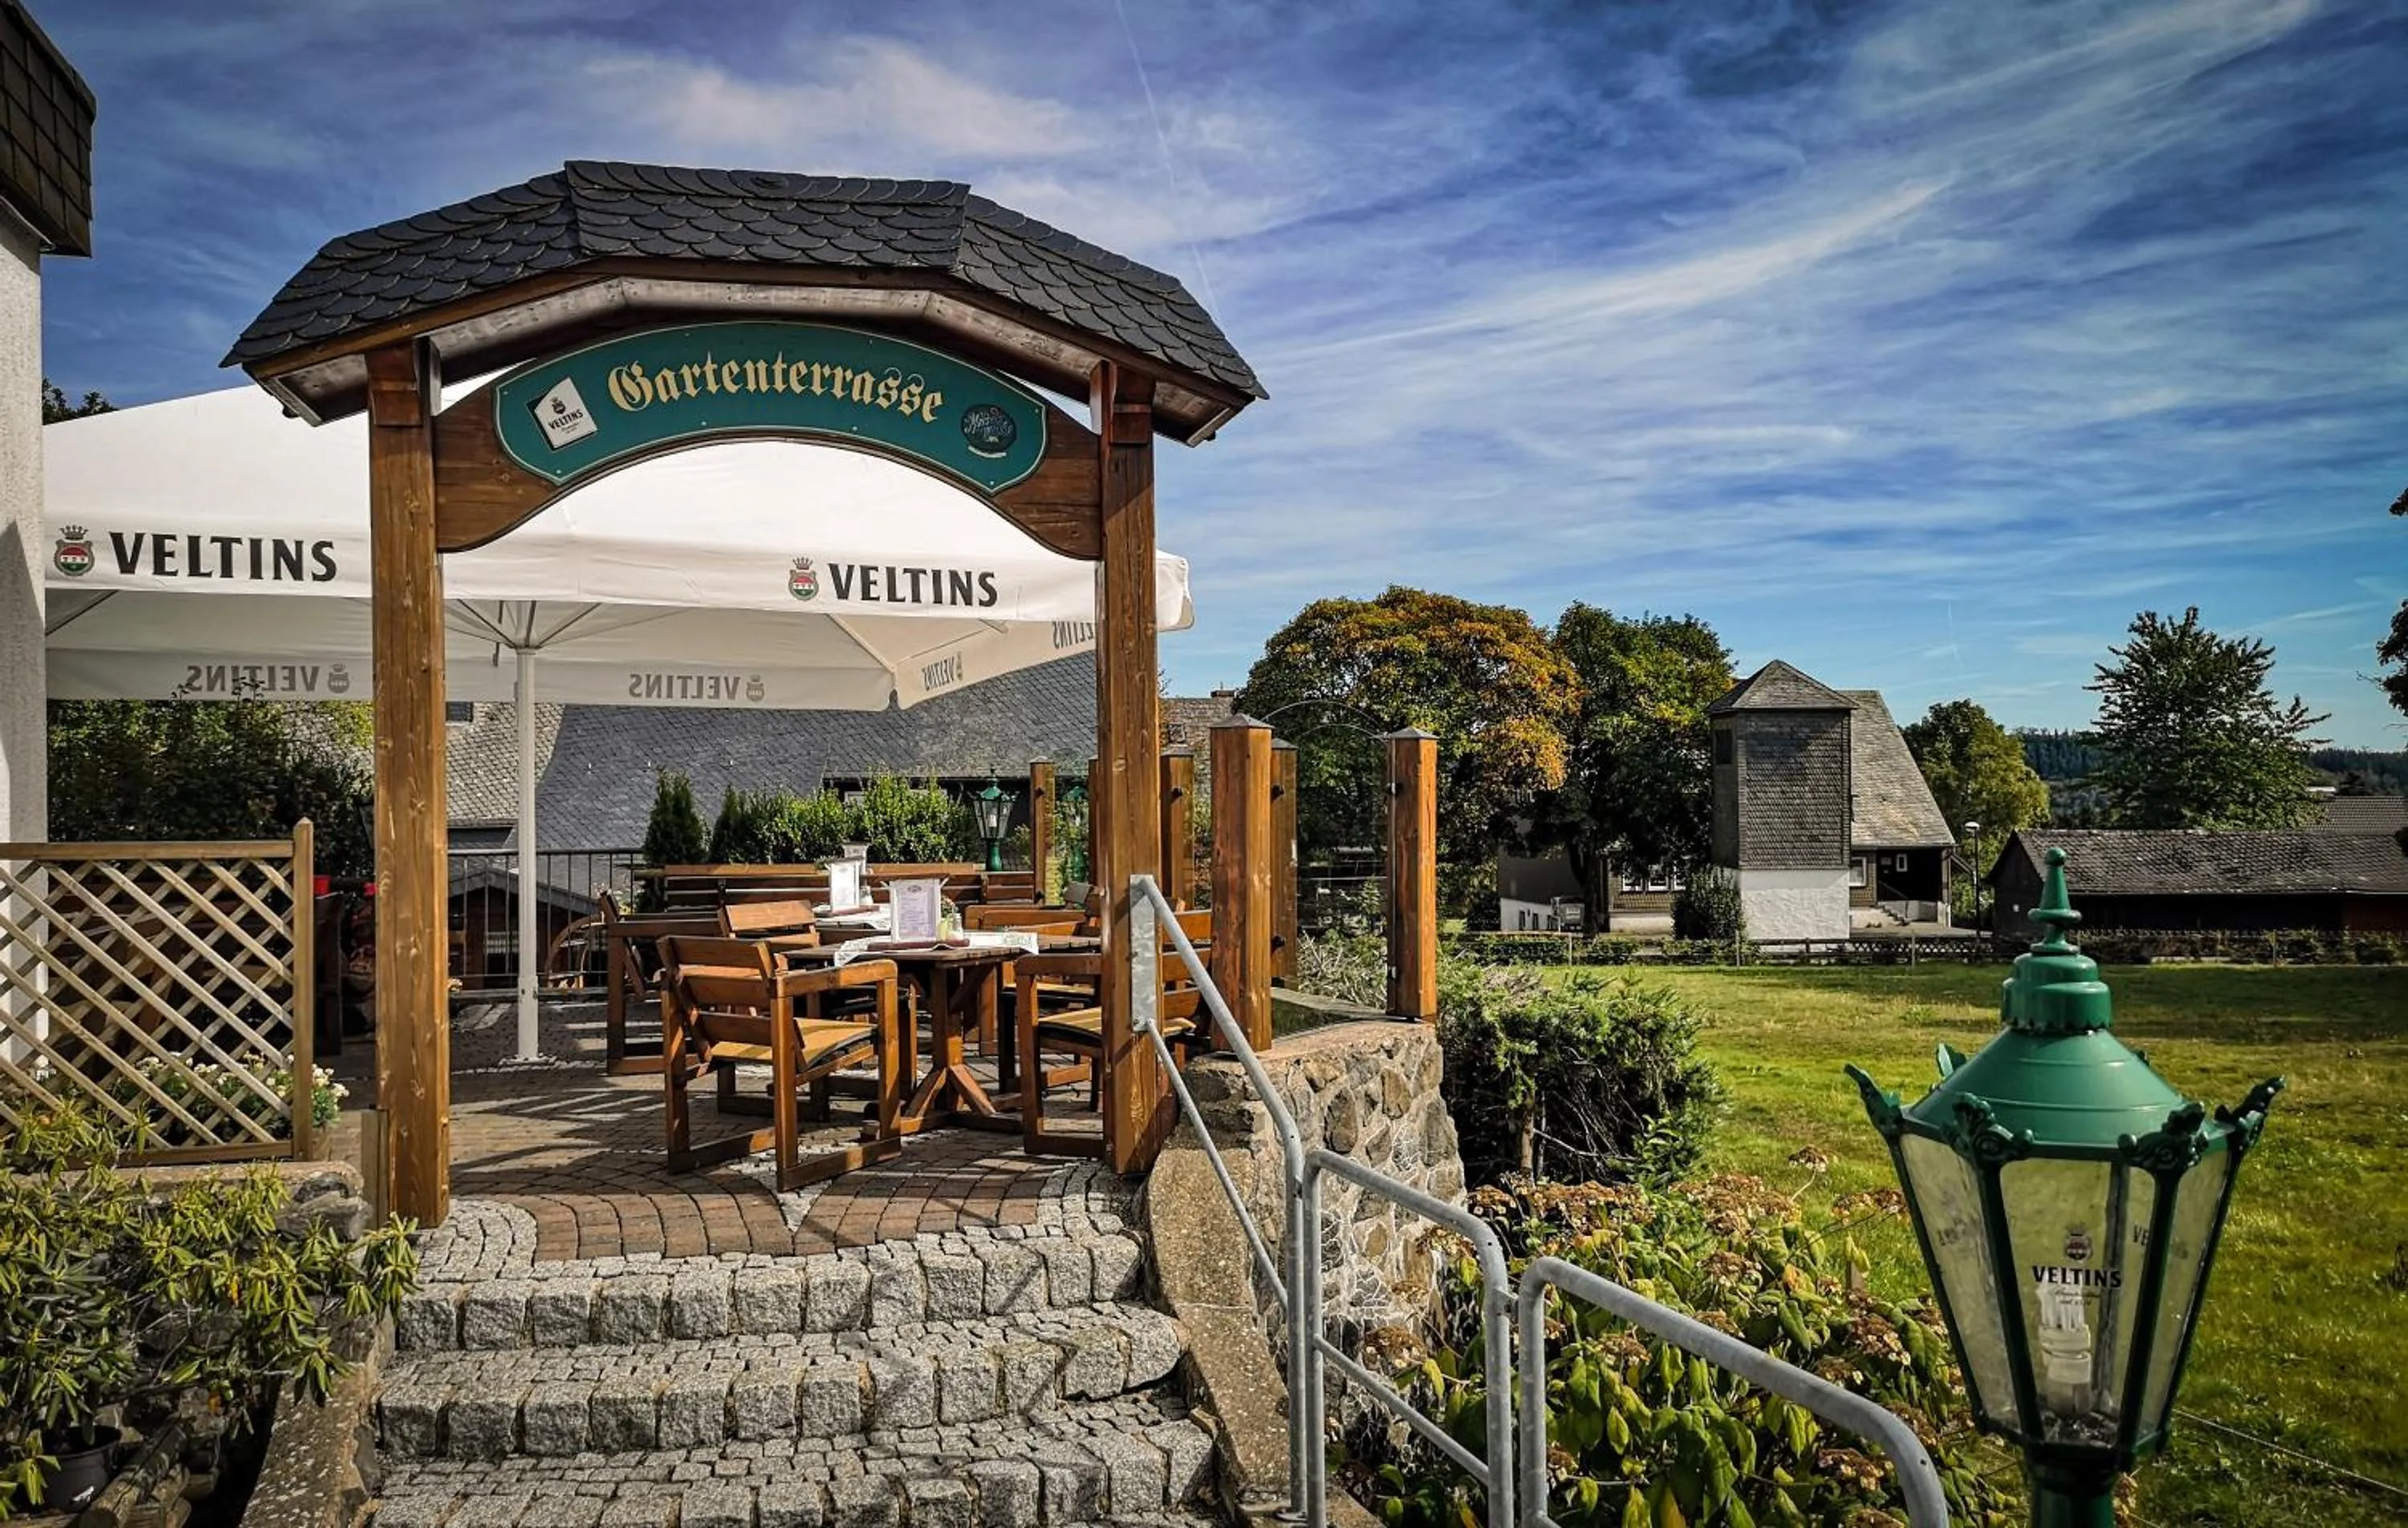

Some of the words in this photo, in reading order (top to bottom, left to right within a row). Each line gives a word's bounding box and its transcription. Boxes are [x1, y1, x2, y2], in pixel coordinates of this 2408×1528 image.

[607, 350, 943, 423] Gartenterrasse
[548, 408, 584, 429] VELTINS
[109, 531, 337, 582] VELTINS
[828, 563, 998, 608] VELTINS
[2032, 1266, 2121, 1287] VELTINS
